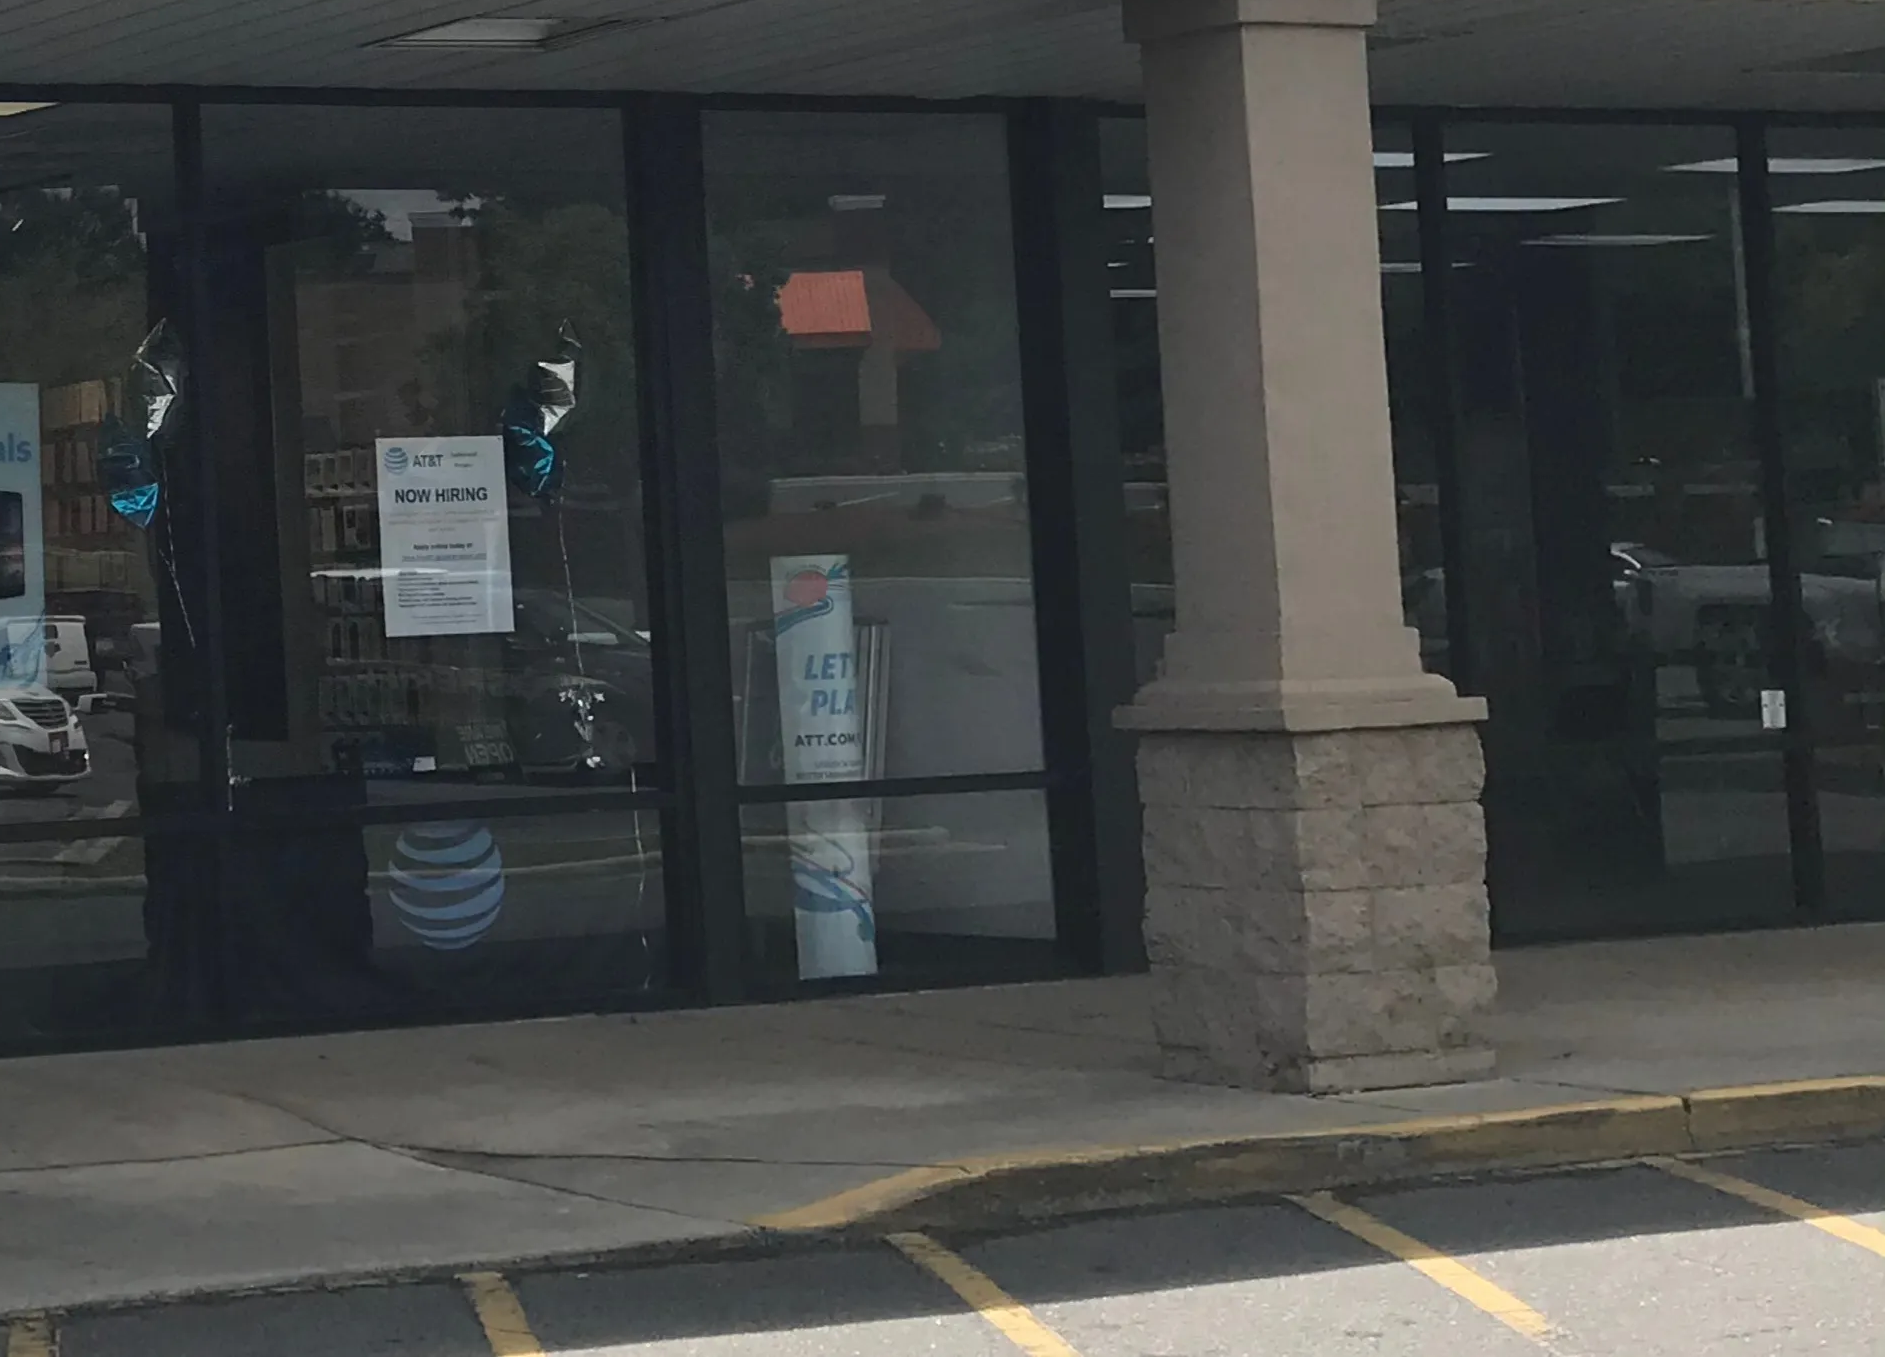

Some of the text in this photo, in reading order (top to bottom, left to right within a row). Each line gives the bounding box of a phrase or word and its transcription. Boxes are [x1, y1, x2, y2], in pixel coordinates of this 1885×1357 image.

[412, 454, 444, 468] AT&T
[395, 487, 489, 504] NOW HIRING
